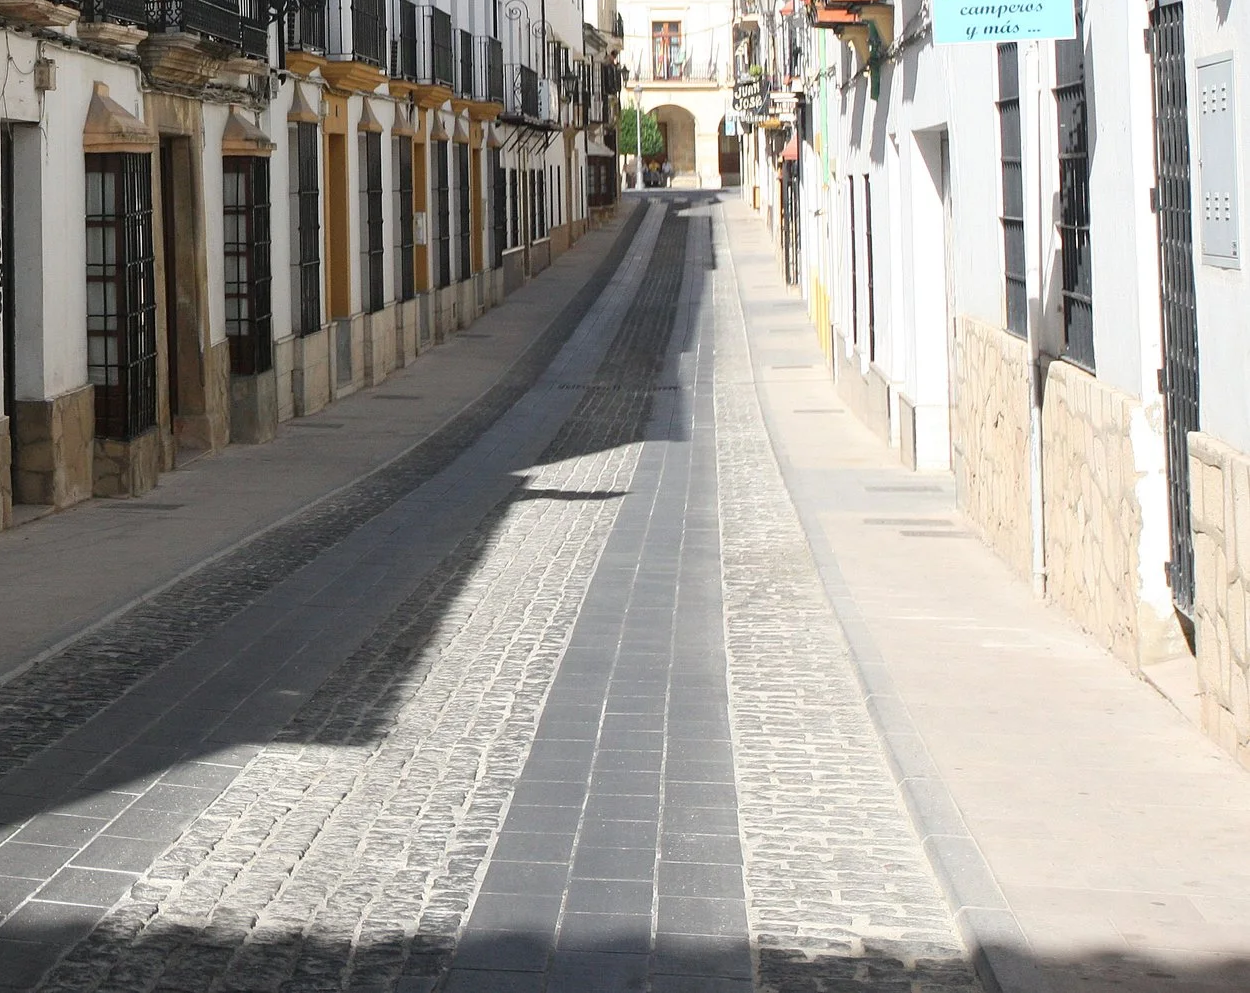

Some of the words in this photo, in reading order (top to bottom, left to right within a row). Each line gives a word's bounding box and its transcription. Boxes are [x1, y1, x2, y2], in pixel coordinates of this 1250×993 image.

[960, 2, 1043, 18] camperos
[966, 25, 978, 40] y
[983, 20, 1020, 35] más
[734, 82, 760, 100] JUAN
